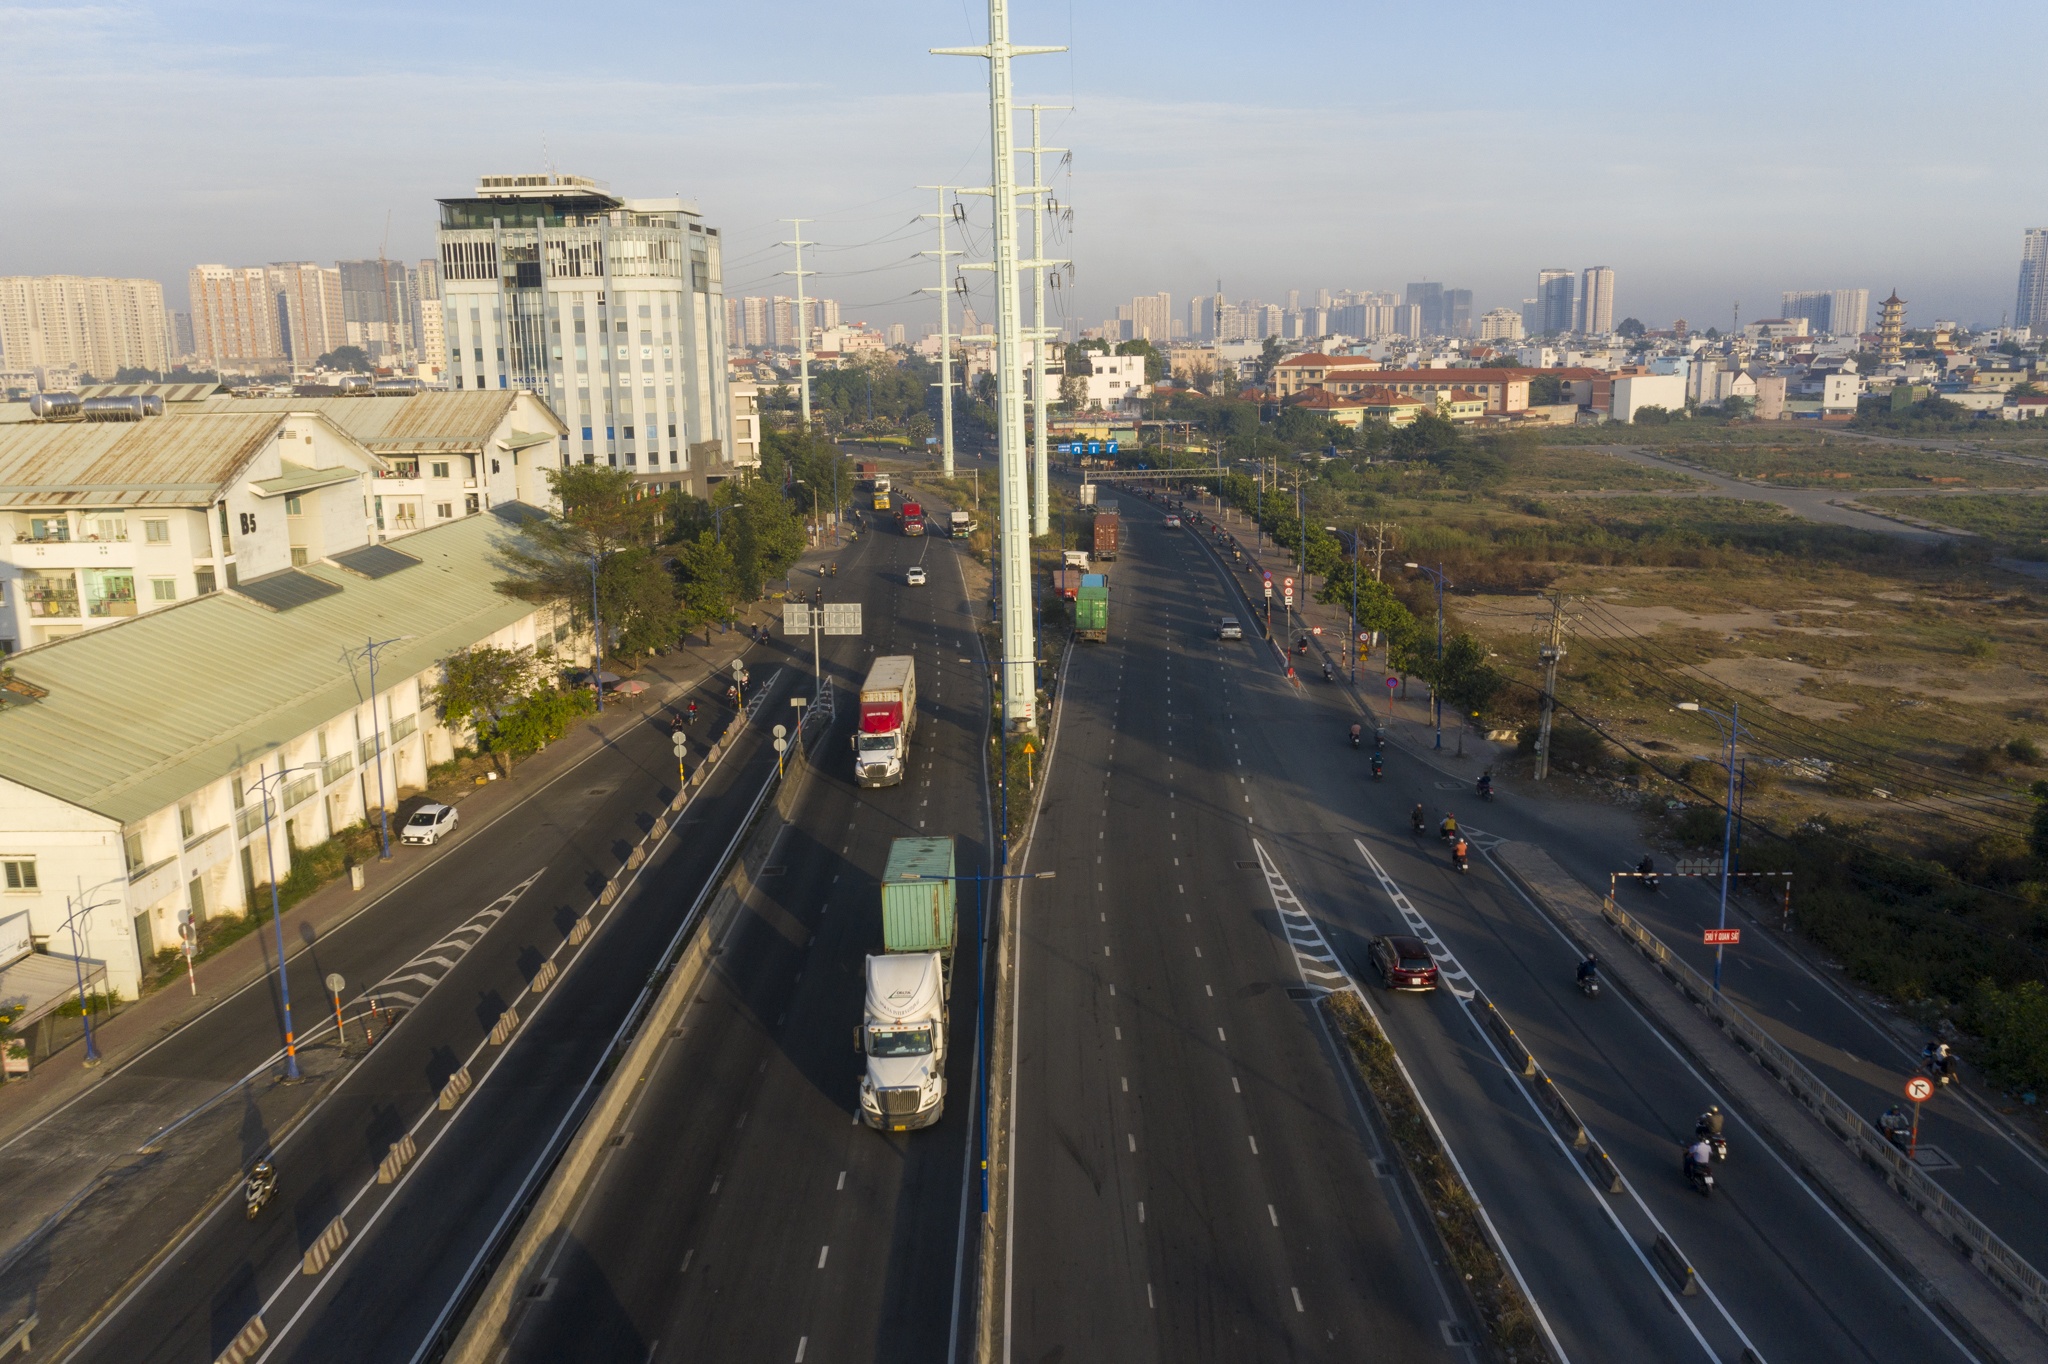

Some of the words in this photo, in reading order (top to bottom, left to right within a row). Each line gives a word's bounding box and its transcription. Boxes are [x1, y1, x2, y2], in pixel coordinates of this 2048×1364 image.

[492, 459, 500, 475] B6
[240, 513, 256, 536] B5
[1718, 932, 1730, 941] QUAN
